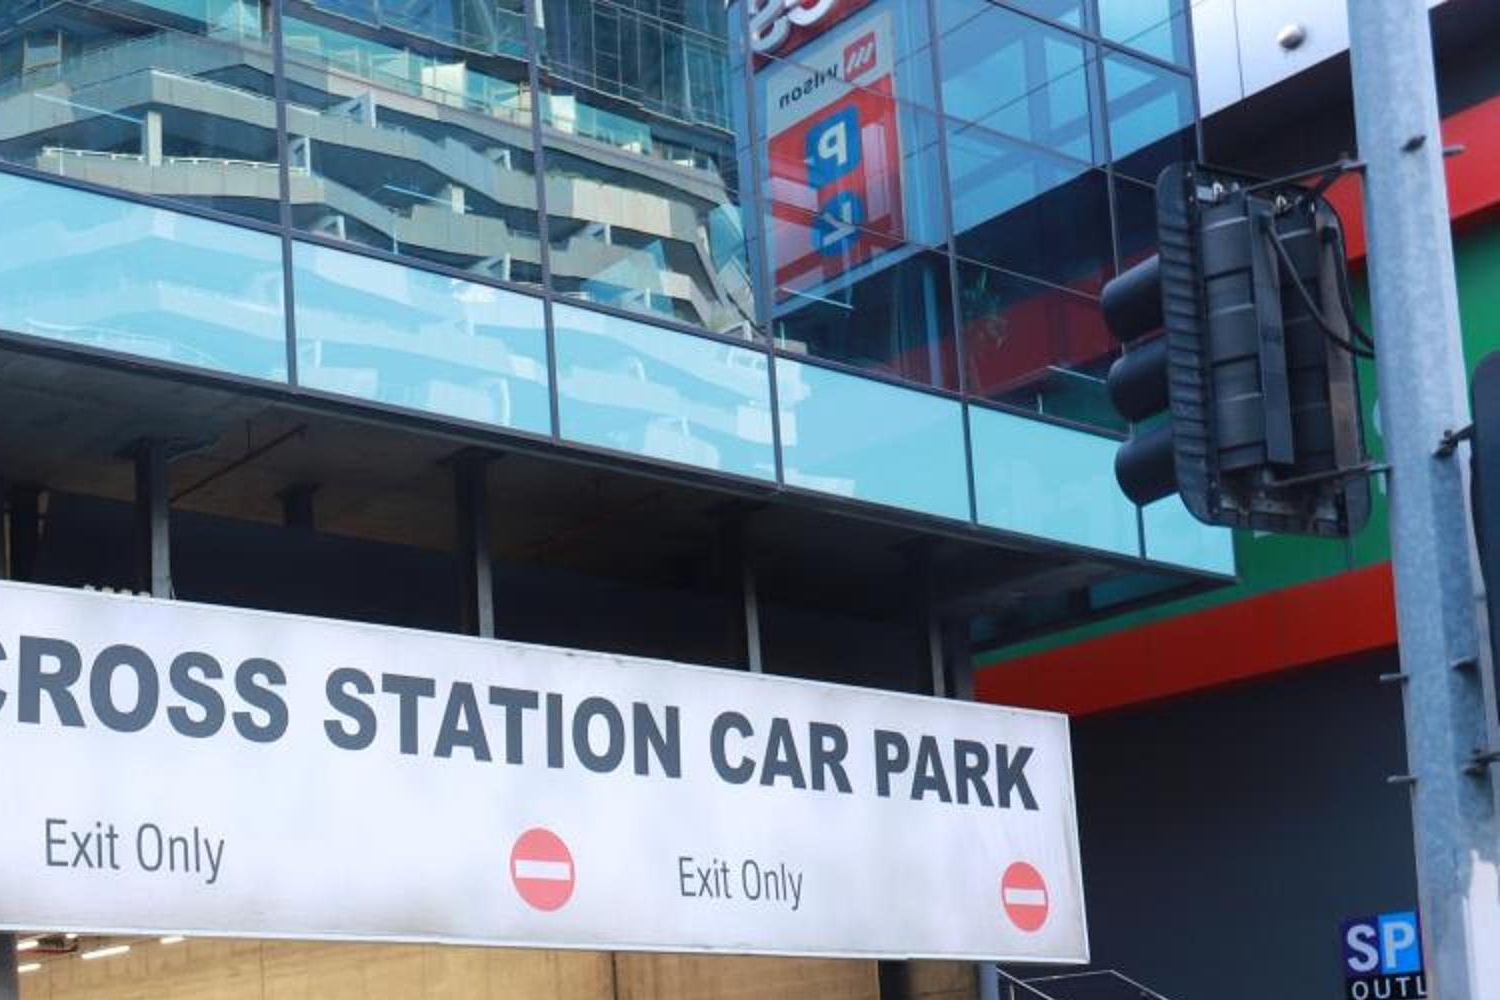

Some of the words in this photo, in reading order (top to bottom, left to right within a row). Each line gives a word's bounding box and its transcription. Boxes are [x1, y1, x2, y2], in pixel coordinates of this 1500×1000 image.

[323, 667, 682, 779] STATION
[709, 710, 853, 794] CAR
[873, 728, 1040, 811] PARK
[44, 818, 120, 871] Exit
[135, 823, 225, 884] Only
[678, 856, 731, 899] Exit
[740, 858, 803, 911] Only
